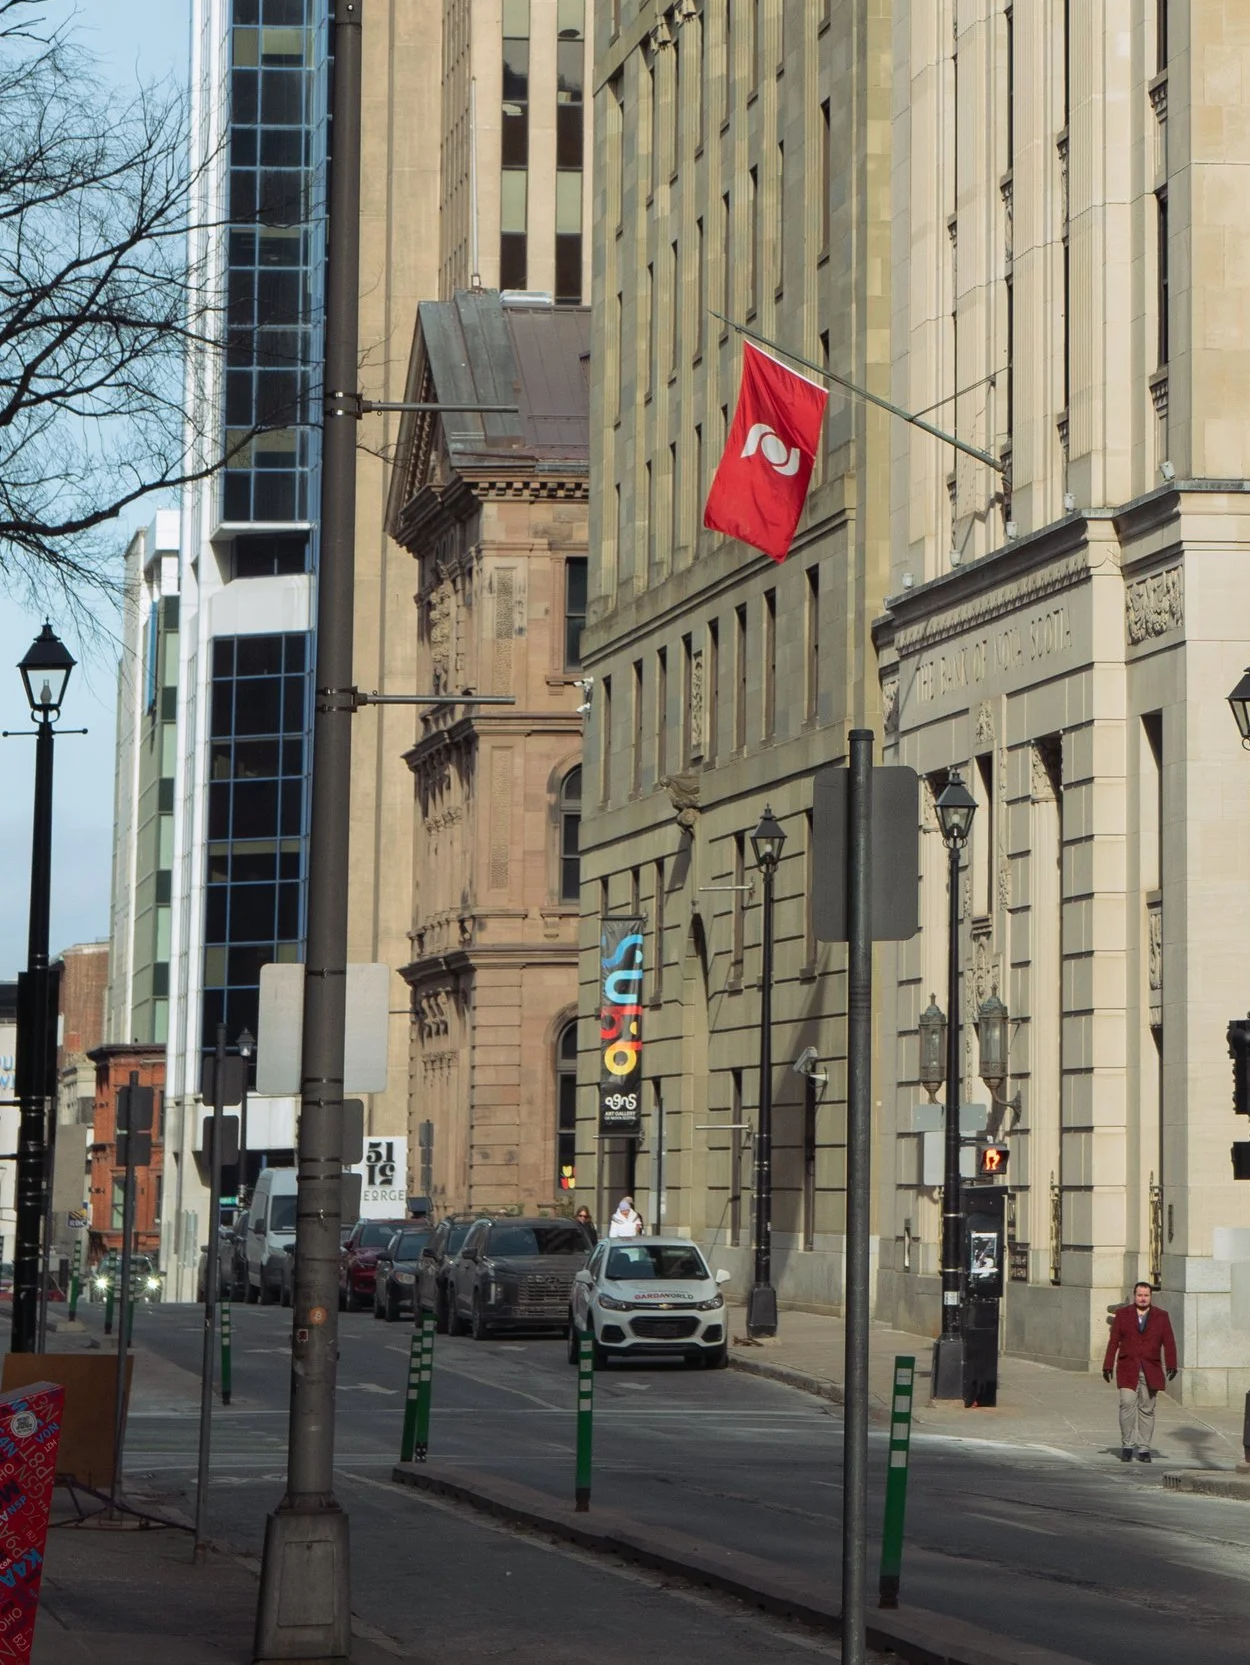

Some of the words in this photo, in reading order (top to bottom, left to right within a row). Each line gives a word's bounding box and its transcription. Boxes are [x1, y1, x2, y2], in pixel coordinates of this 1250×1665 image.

[916, 661, 934, 704] THE
[940, 647, 969, 696] BANK
[973, 639, 987, 682] OF
[993, 626, 1024, 674] NOVA
[1030, 607, 1073, 661] SCOTIA
[366, 1142, 395, 1164] 51
[634, 1292, 694, 1300] GARDAWORLD
